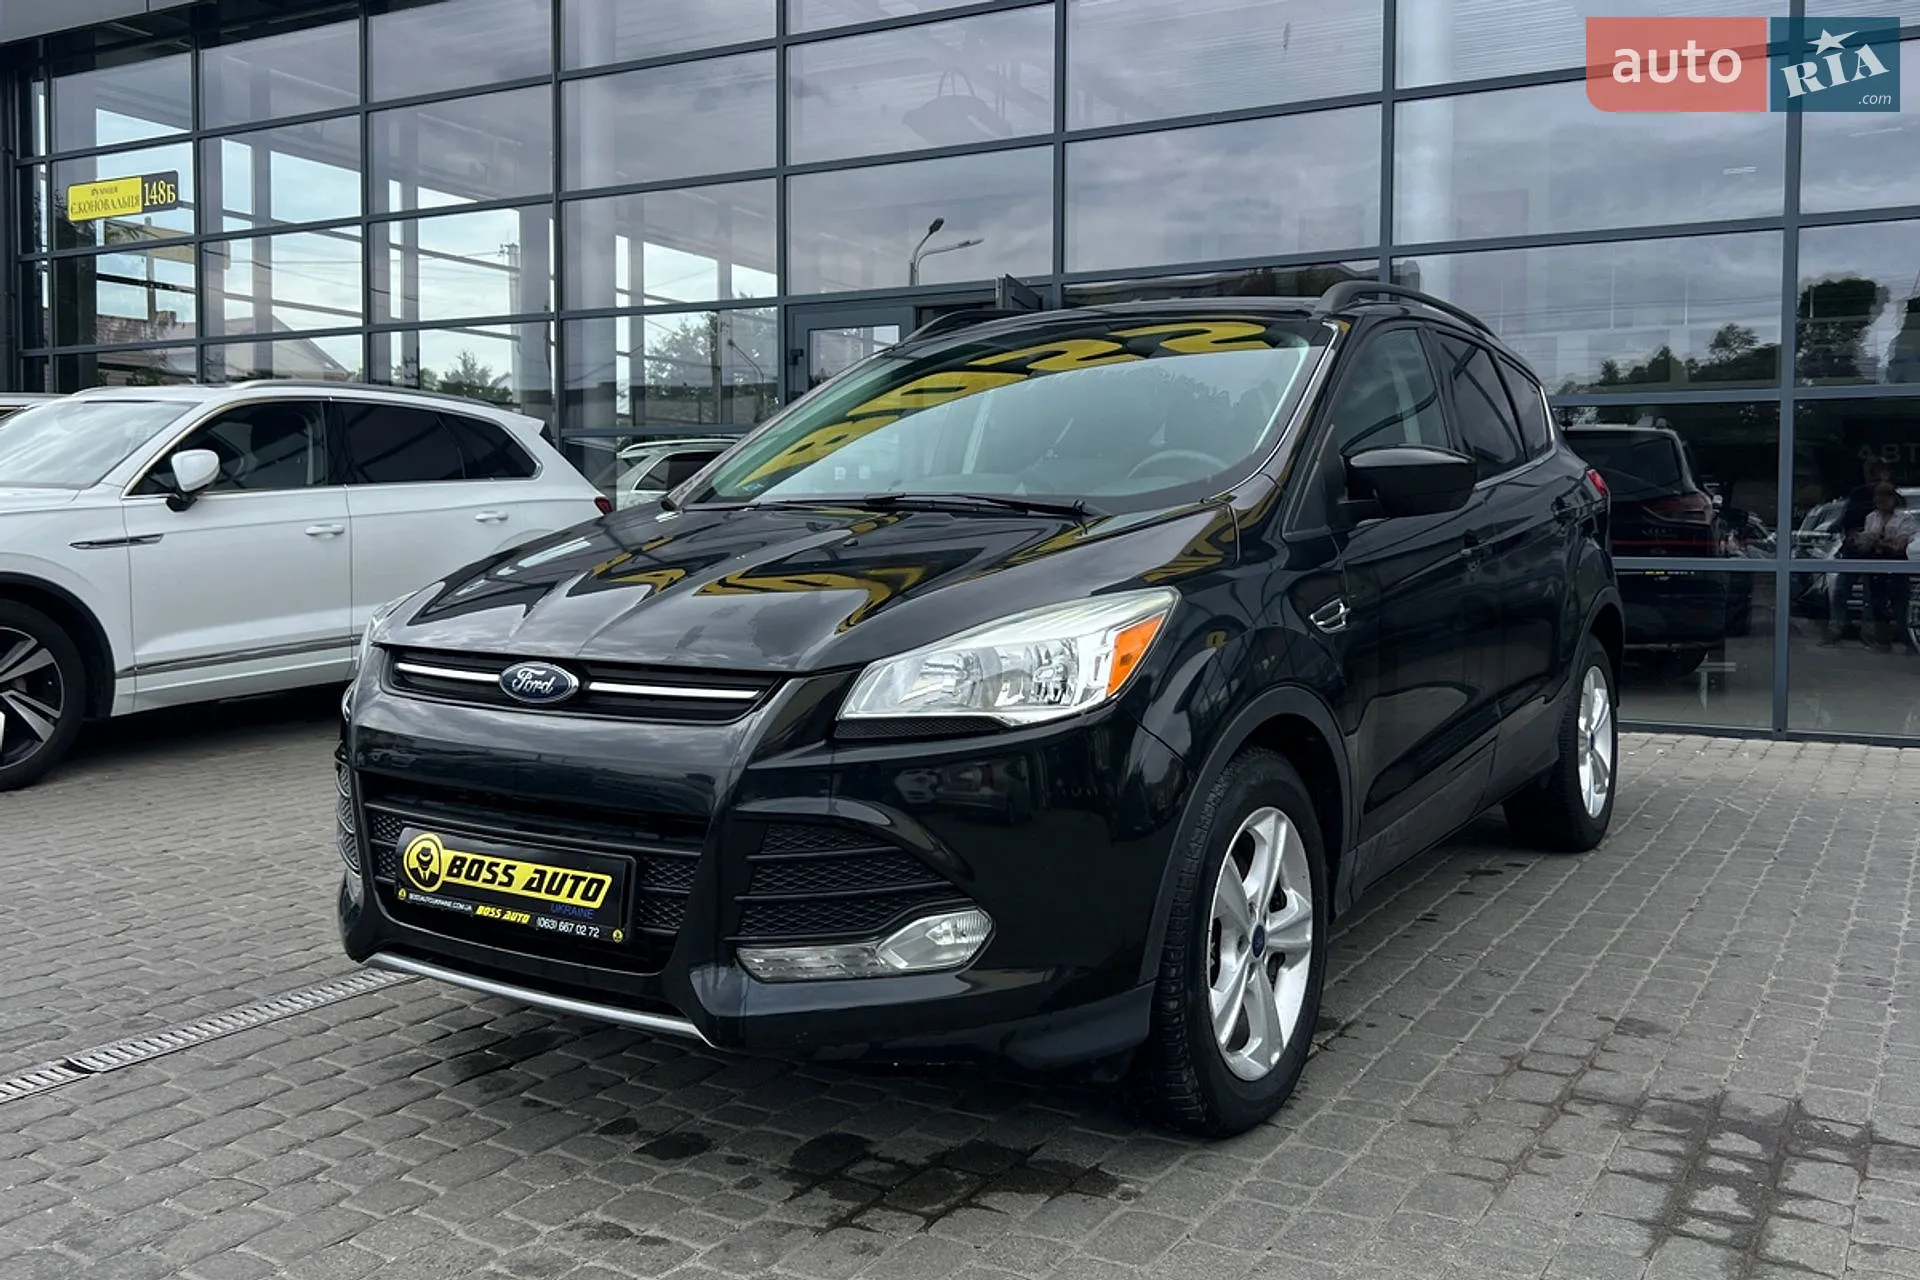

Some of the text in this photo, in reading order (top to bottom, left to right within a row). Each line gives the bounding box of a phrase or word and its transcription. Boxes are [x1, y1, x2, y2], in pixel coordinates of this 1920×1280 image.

[144, 180, 176, 206] 148Б
[512, 668, 556, 694] Ford
[446, 855, 606, 902] BOSS AUTO
[475, 905, 502, 918] BOSS
[503, 911, 531, 924] AUTO
[536, 917, 557, 930] (063)
[559, 921, 574, 933] 667
[576, 924, 587, 936] 02
[588, 926, 600, 938] 72
[550, 903, 594, 919] UKRAINE
